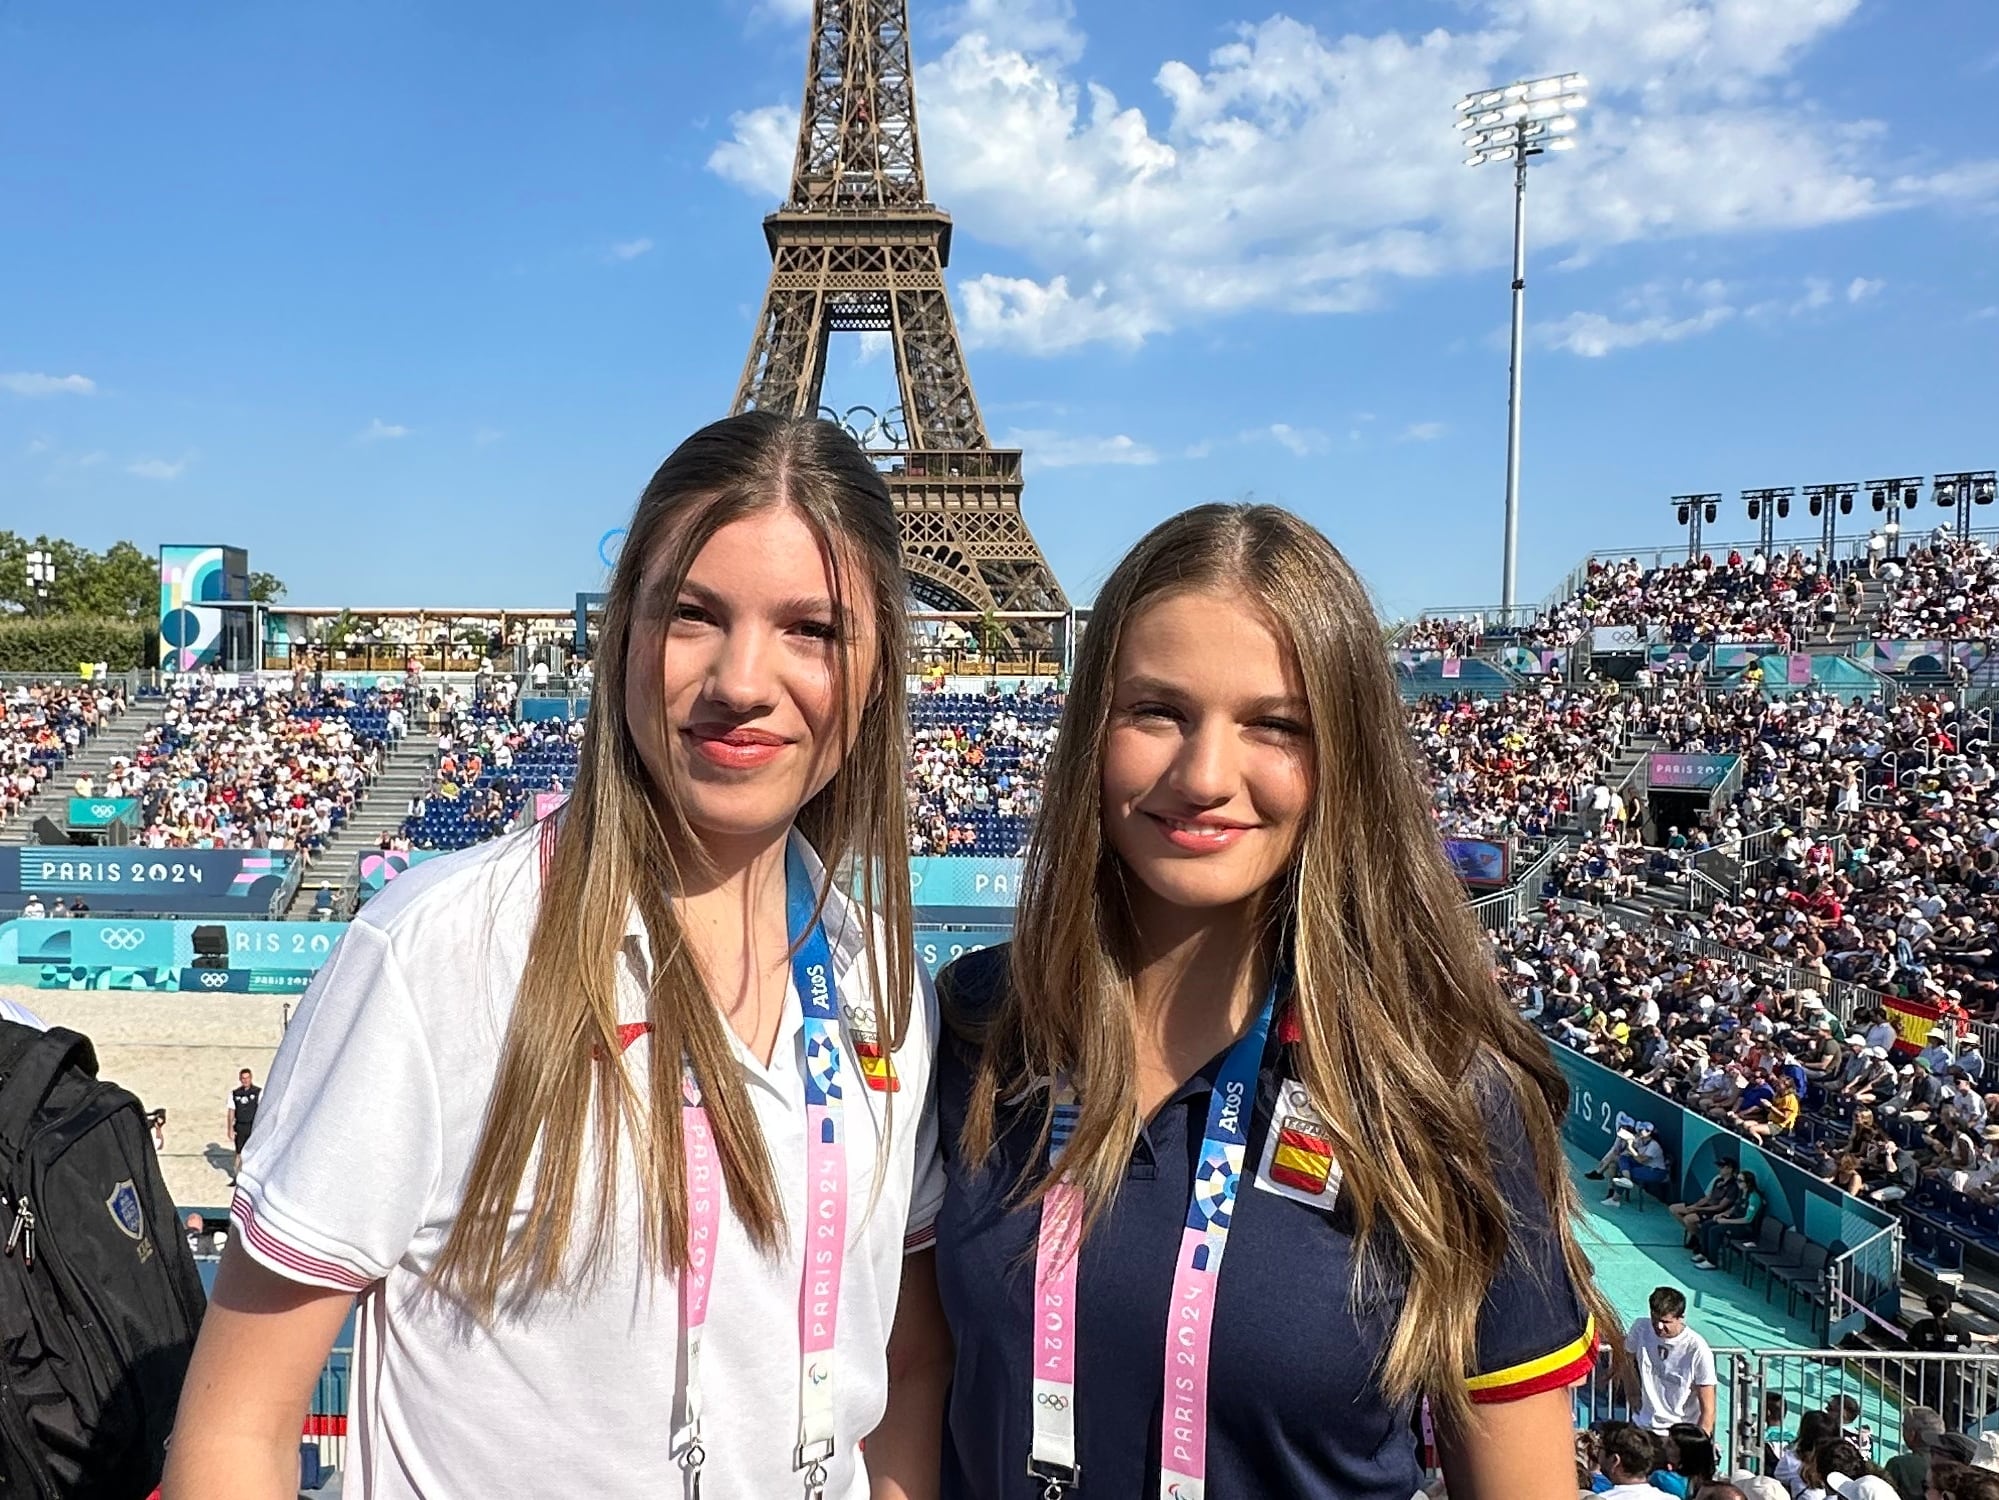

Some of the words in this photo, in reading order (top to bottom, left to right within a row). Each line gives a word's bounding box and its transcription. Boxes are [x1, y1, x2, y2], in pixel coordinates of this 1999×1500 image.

[1656, 764, 1693, 775] PARIS
[42, 862, 121, 881] PARIS
[131, 863, 202, 883] 2024
[235, 932, 280, 953] RIS
[292, 933, 342, 953] 20
[692, 1124, 711, 1214] PARIS
[817, 1160, 838, 1239] 2024
[693, 1226, 709, 1311] 2024
[813, 1249, 834, 1338] PARIS
[1044, 1294, 1064, 1369] 2024
[1176, 1286, 1203, 1366] 2024
[1173, 1376, 1195, 1462] PARIS
